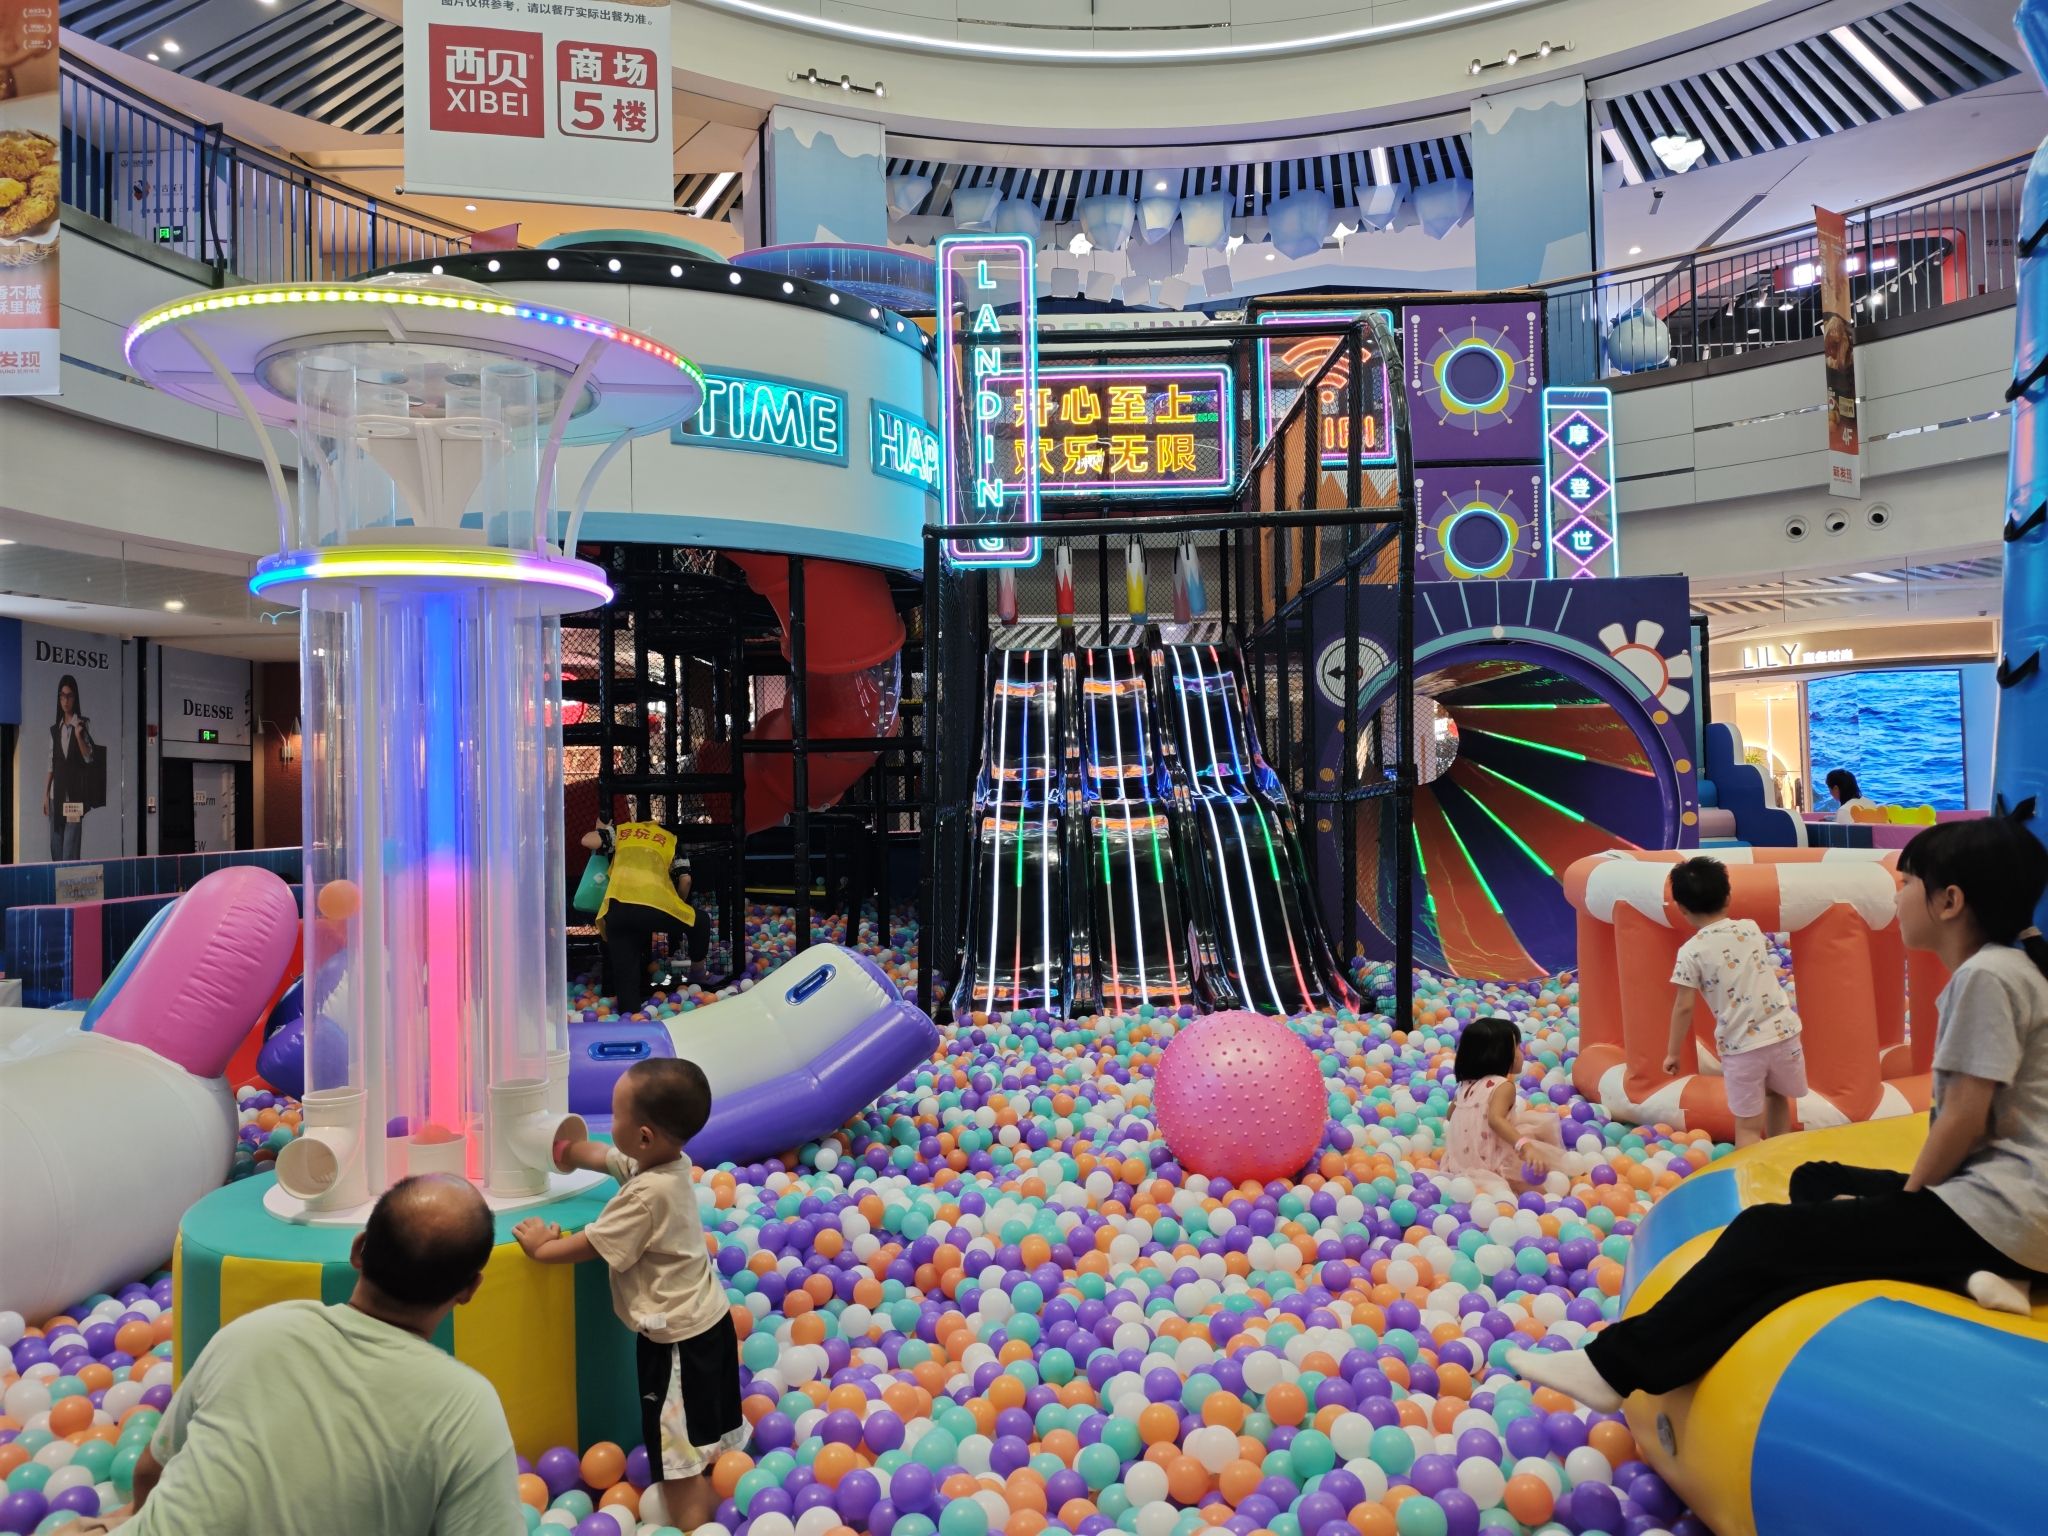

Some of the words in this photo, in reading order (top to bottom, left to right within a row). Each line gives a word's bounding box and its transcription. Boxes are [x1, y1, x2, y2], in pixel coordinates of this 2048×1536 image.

[446, 45, 527, 88] 西贝
[569, 48, 649, 86] 商场
[447, 88, 528, 117] XIBEI
[571, 91, 647, 132] 5楼
[698, 378, 838, 454] TIME
[1013, 384, 1196, 428] 开心至上
[1014, 434, 1197, 475] 欢乐无限
[35, 639, 109, 670] DEESSE
[1742, 643, 1800, 669] LILY
[183, 698, 234, 720] DEESSE
